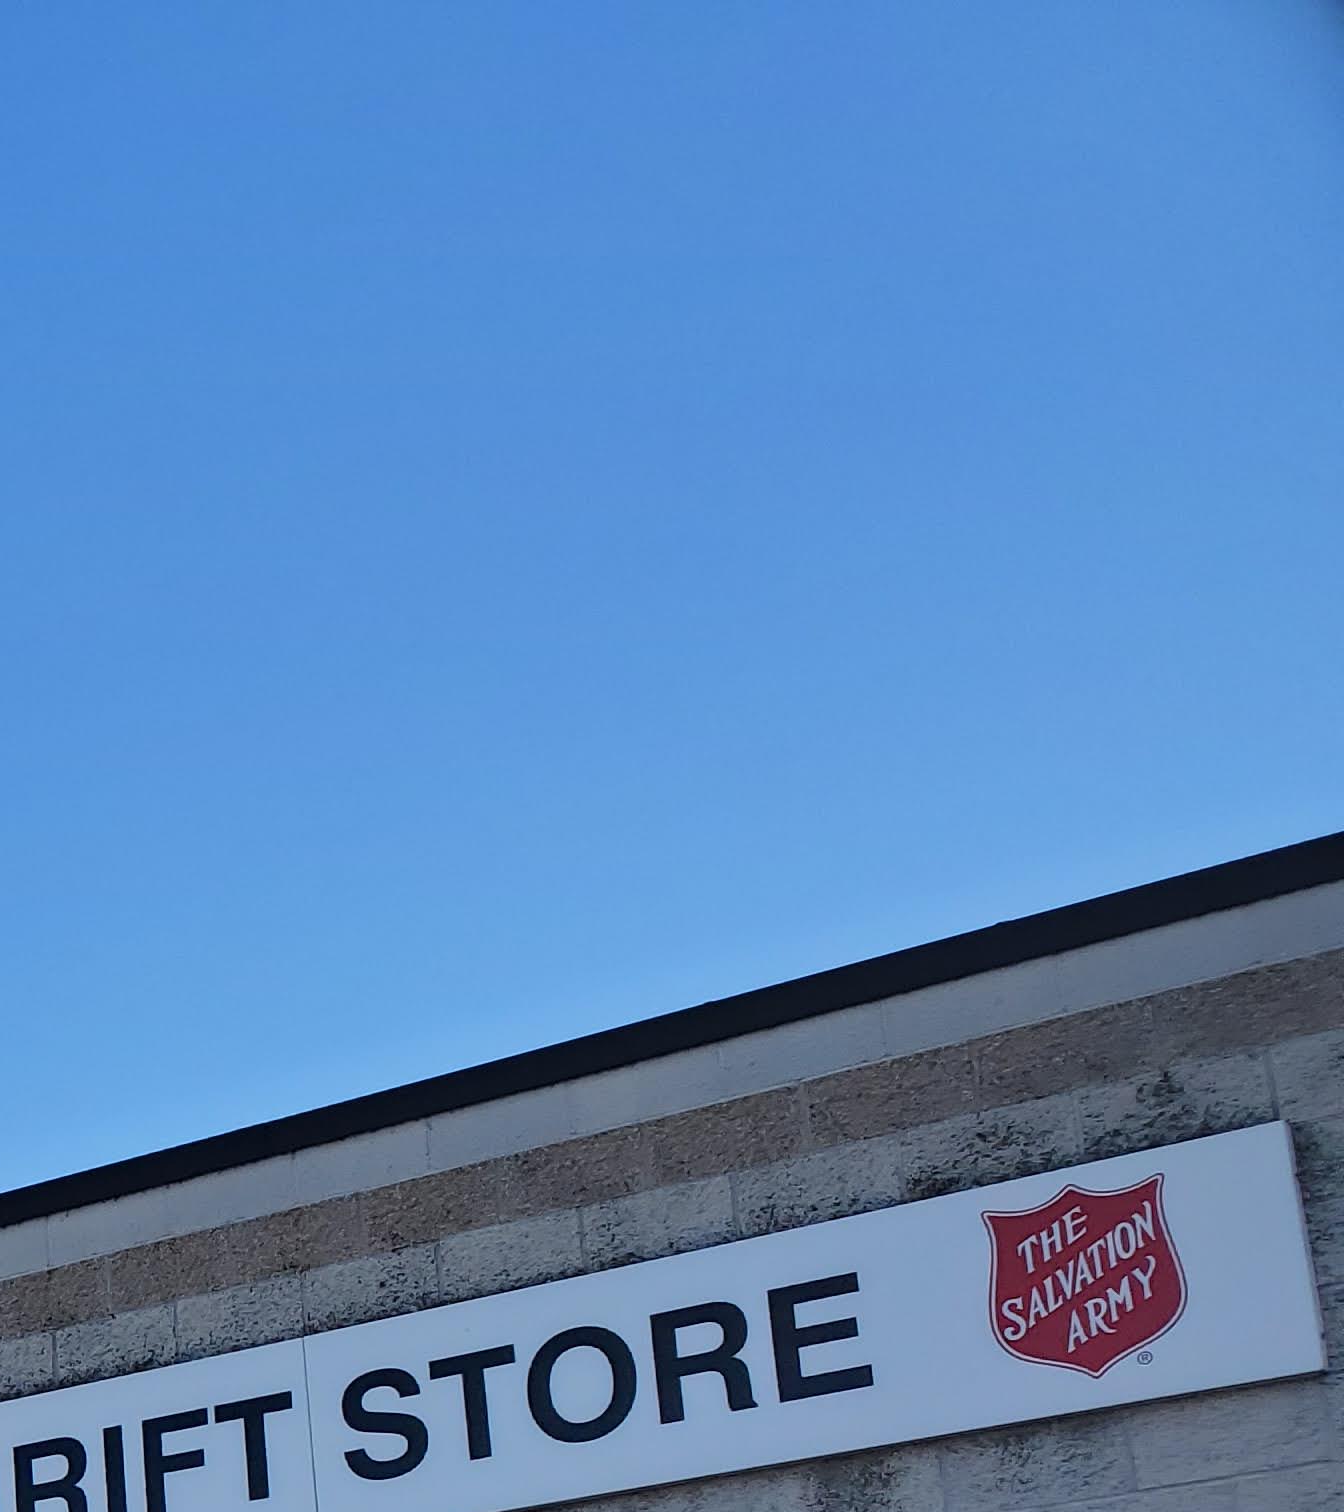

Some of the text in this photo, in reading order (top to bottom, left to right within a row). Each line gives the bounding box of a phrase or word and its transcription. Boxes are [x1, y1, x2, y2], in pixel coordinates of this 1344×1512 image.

[1002, 1201, 1156, 1341] SALVATION
[1017, 1206, 1088, 1274] THE
[1068, 1255, 1156, 1353] ARMY
[341, 1271, 874, 1481] STORE
